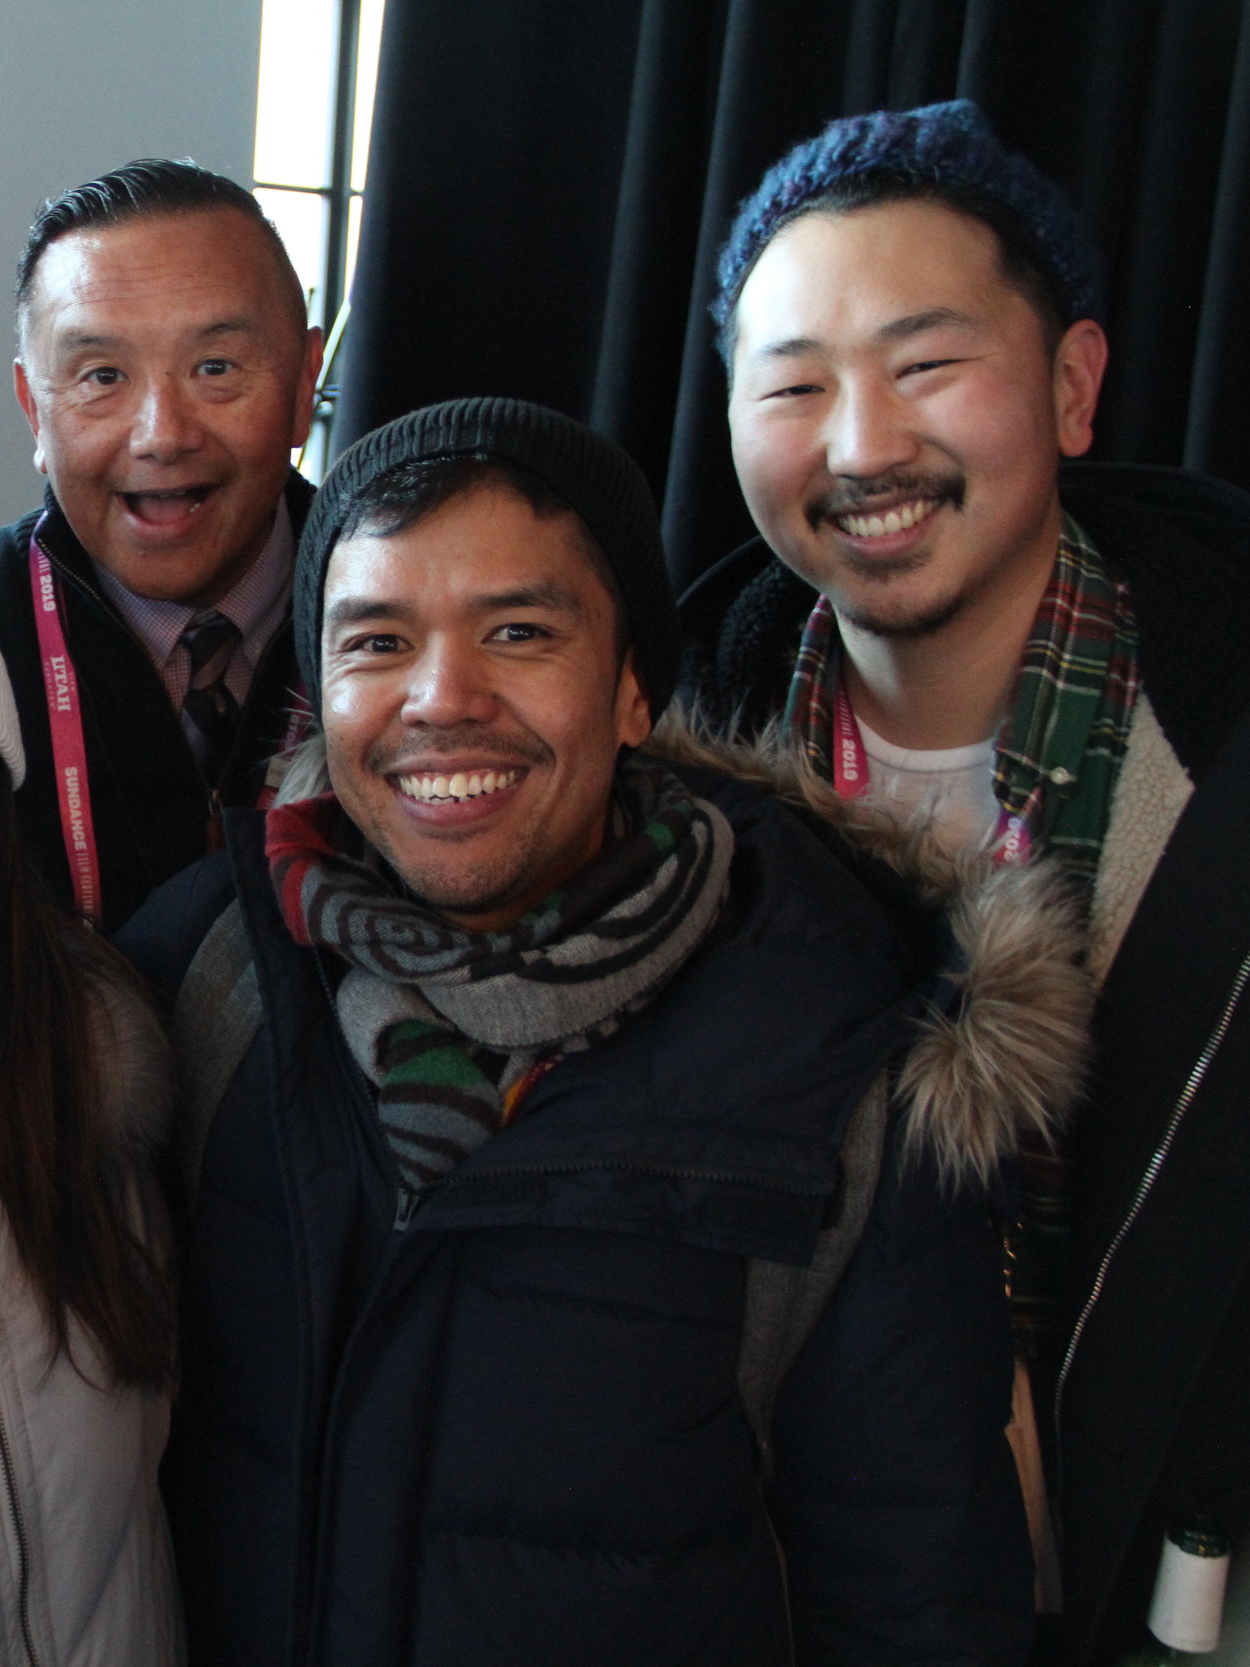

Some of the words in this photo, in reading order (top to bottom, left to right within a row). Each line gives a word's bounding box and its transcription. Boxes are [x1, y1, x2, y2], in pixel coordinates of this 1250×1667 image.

[40, 574, 56, 612] 2019
[51, 655, 71, 712] UTAH
[842, 739, 858, 781] 2019
[65, 767, 87, 851] SUNDANCE
